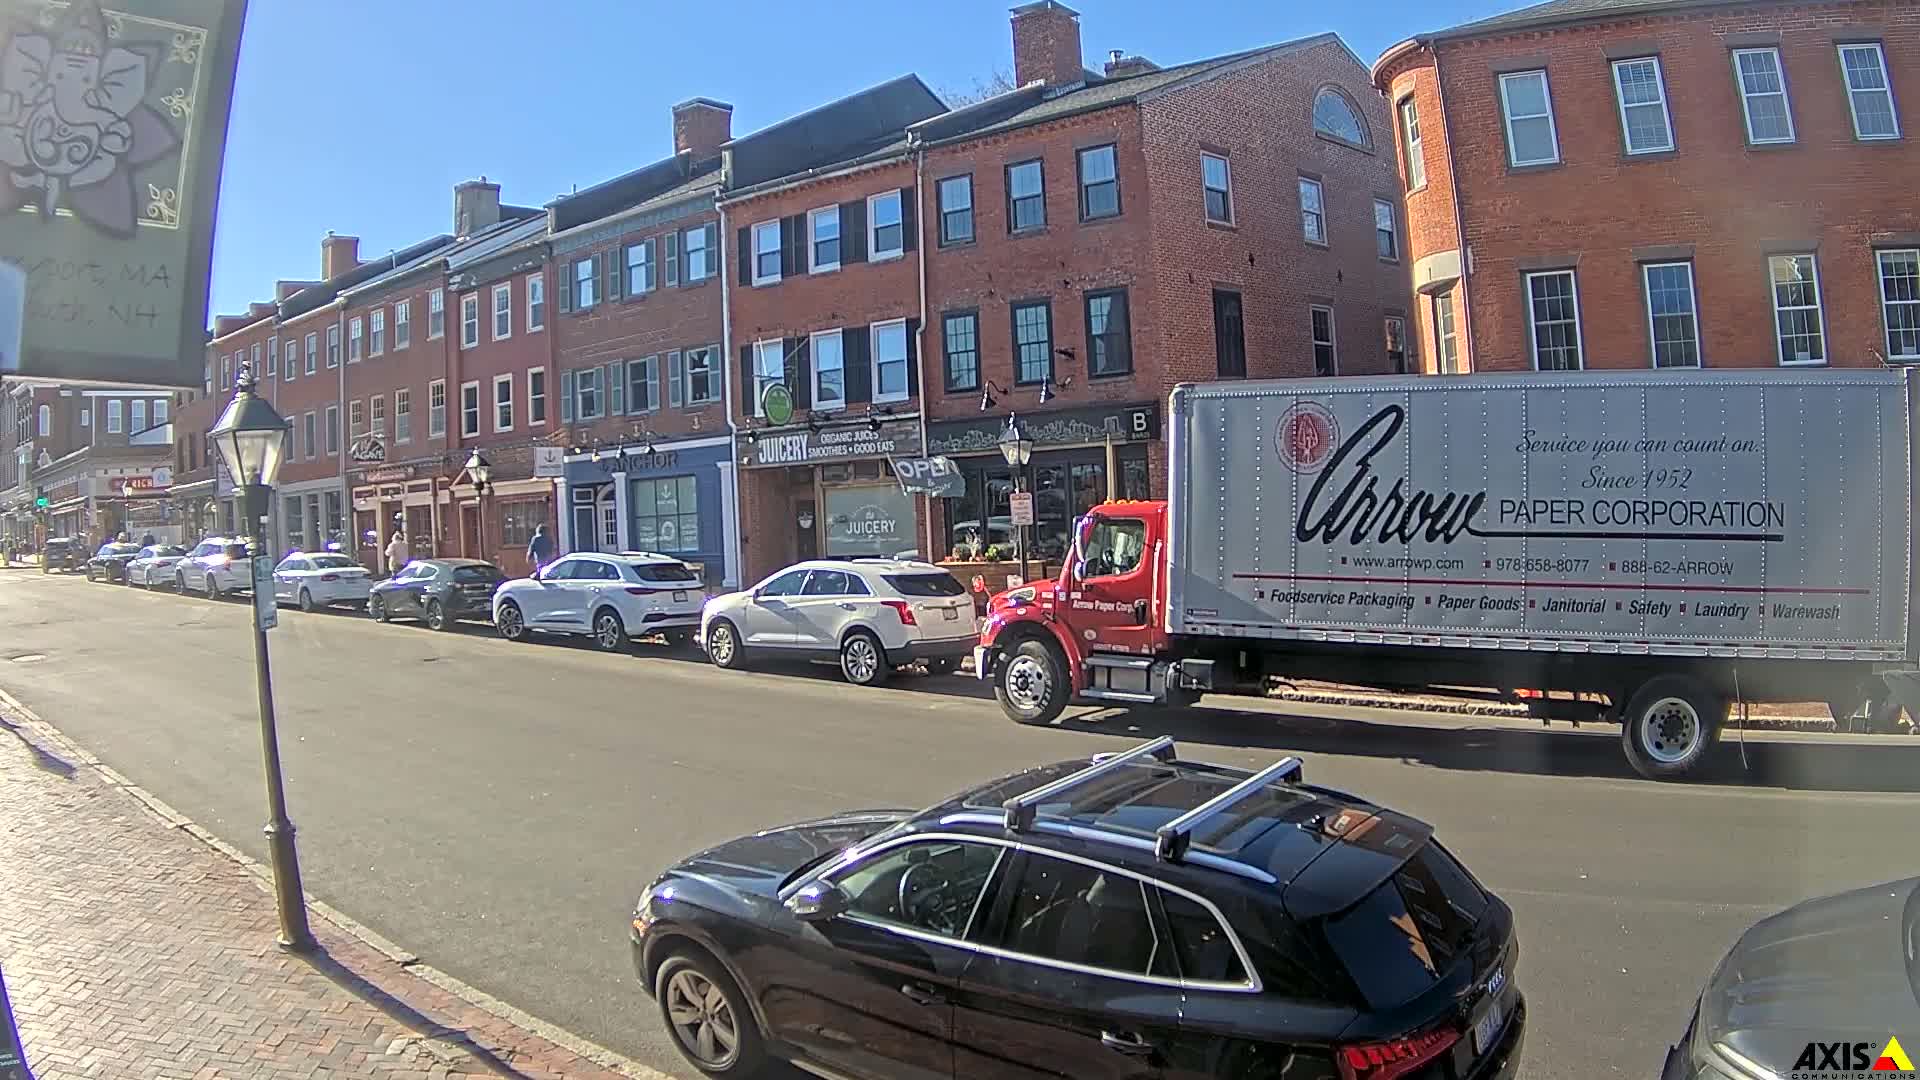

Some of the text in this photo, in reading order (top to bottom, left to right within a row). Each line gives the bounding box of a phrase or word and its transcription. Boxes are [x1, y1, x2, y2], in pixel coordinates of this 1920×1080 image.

[757, 433, 809, 463] JUICERY
[853, 443, 877, 454] GOOD
[876, 441, 895, 453] EATS
[1515, 429, 1761, 461] Service you can count on.
[1581, 465, 1694, 490] Since 1952
[846, 519, 896, 534] JUICERY
[1499, 499, 1785, 528] PAPER CORPORATION
[1352, 555, 1464, 572] www.arrowp.com
[1621, 560, 1735, 576] 888-62-ARROW
[1270, 588, 1840, 621] Foodservice Packaging Paper Goods Janitorial Safety Laundry Warewash
